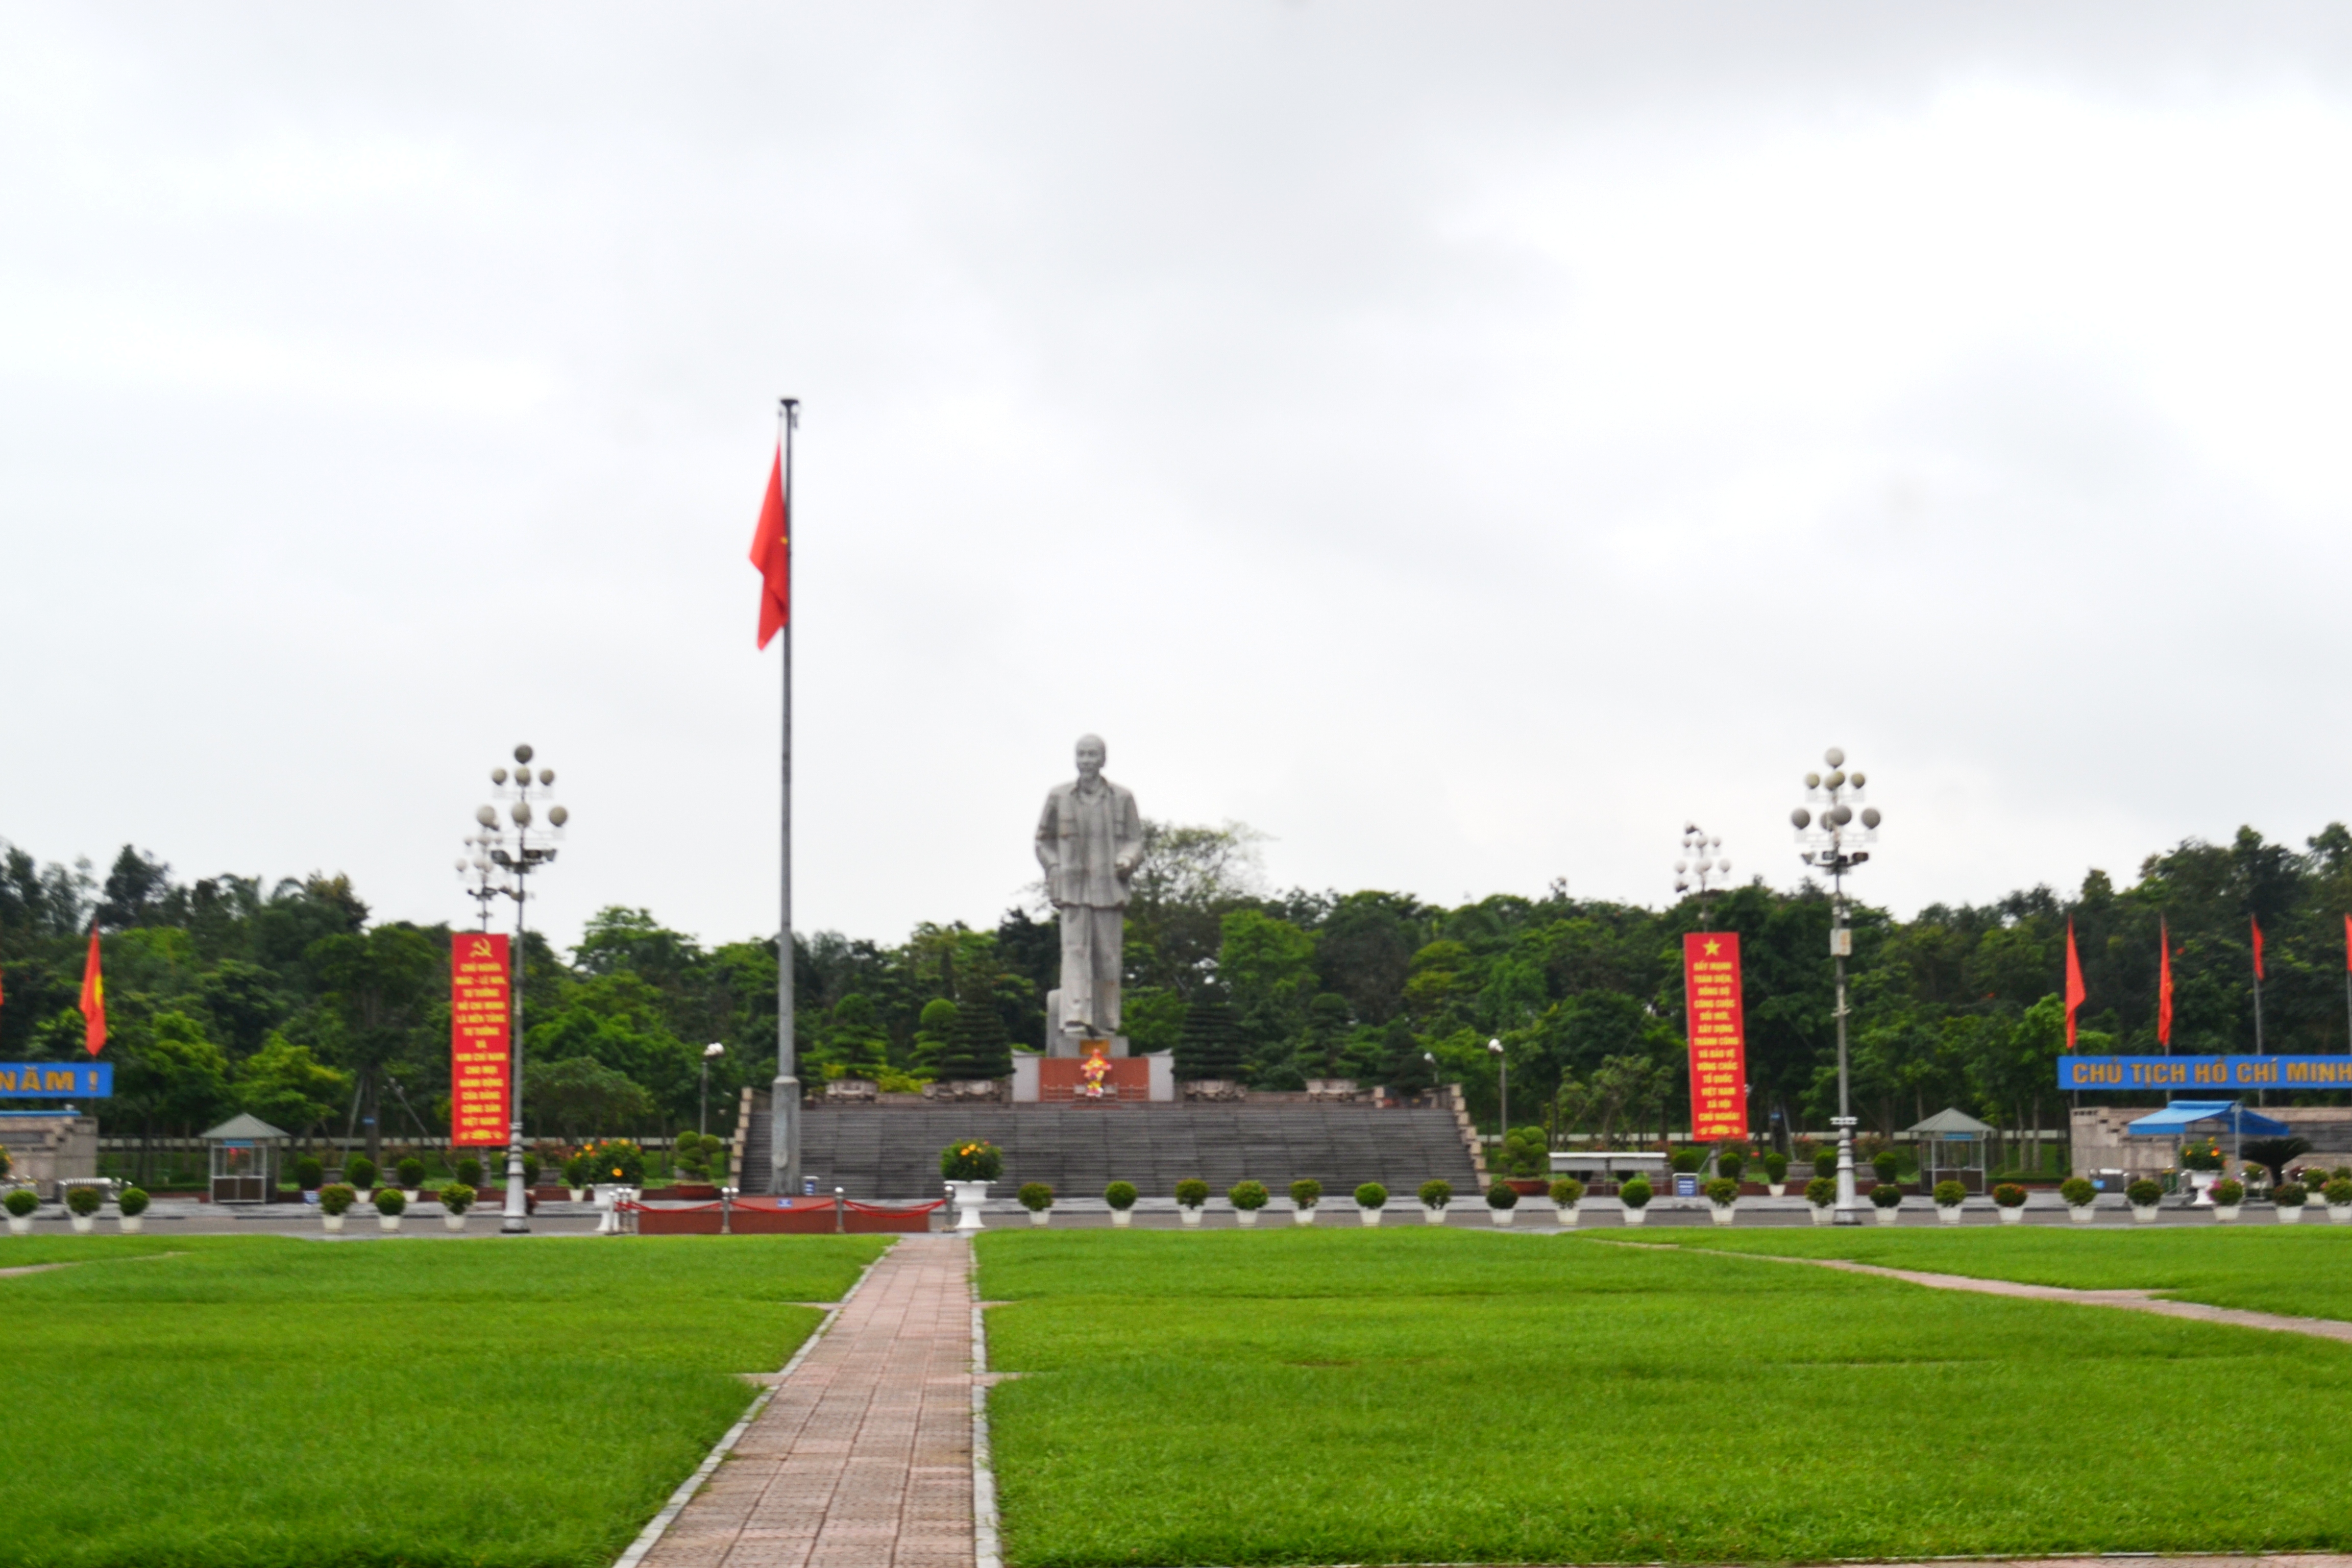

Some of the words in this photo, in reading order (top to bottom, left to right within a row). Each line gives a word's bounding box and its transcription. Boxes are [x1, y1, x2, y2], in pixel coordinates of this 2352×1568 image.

[0, 1065, 75, 1092] NĂM
[2072, 1056, 2122, 1084] CHỦ
[2129, 1062, 2187, 1089] TỊCH
[2236, 1057, 2278, 1084] CHÍ
[2286, 1062, 2352, 1084] MINH
